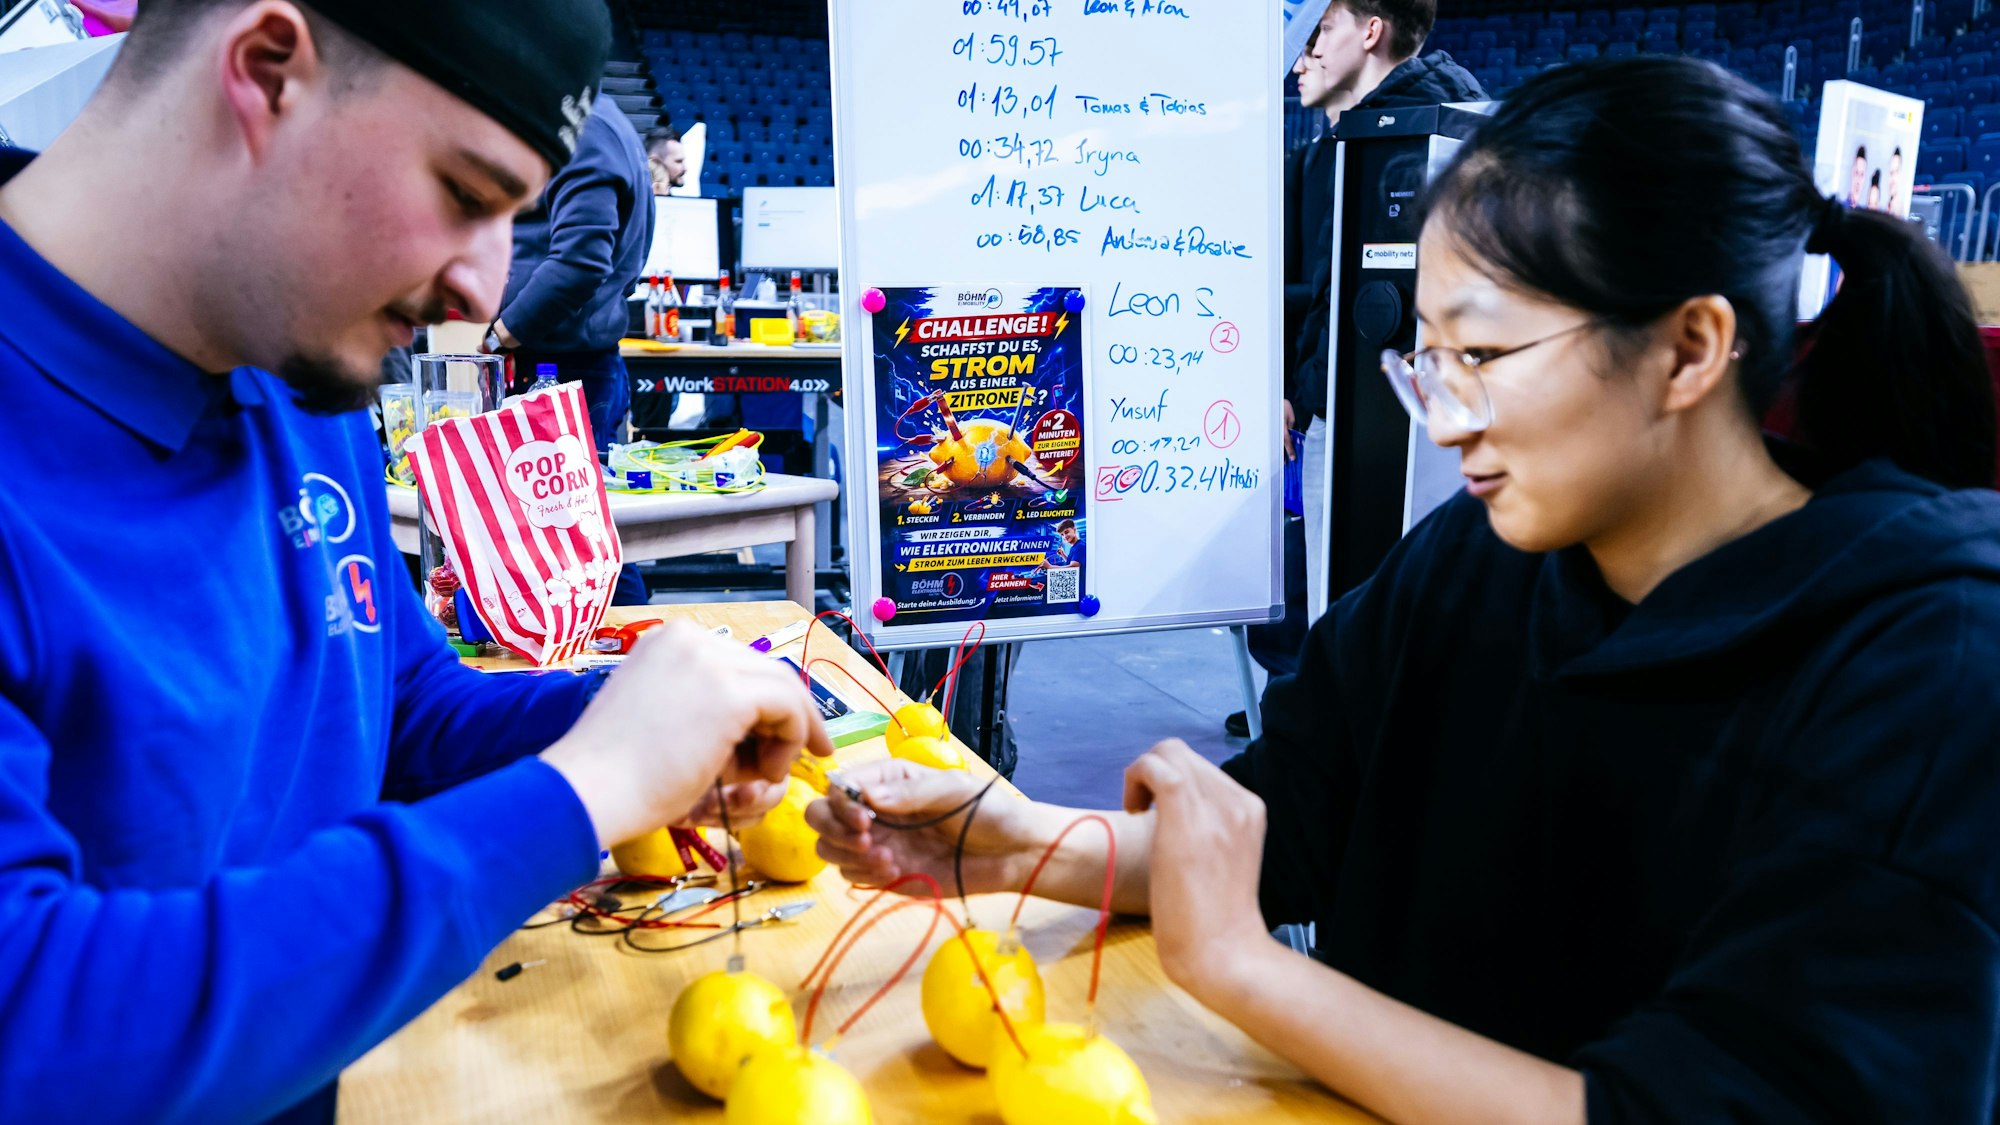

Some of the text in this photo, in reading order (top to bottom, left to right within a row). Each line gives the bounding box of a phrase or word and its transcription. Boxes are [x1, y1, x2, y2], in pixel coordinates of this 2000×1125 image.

[958, 82, 1207, 119] 01:13,01 Tomas & Tobias
[959, 133, 1059, 168] 00:34,72
[1080, 186, 1140, 213] Luca
[958, 291, 987, 301] BÖHM
[1108, 282, 1222, 319] Leon S.
[917, 316, 1048, 339] CHALLENGE!
[1219, 328, 1234, 346] 2
[921, 339, 1042, 358] SCHAFFST DU ES,
[929, 354, 1035, 380] STROM
[950, 377, 1017, 390] AUS EINER
[950, 389, 1048, 408] ZITRONE ?
[1110, 389, 1169, 422] Yusuf
[1042, 412, 1065, 431] IN 2
[1211, 411, 1228, 440] 1
[1038, 429, 1076, 440] MINUTEN
[1037, 440, 1077, 450] ZUR EIGENEN
[1040, 449, 1074, 460] BATTERIE!
[515, 452, 566, 482] POP
[532, 467, 589, 500] CORN
[537, 501, 564, 517] Fresh
[575, 494, 588, 508] Hot
[897, 515, 940, 525] 1. STECKEN
[951, 512, 1005, 523] 2. VERBINDEN
[1015, 509, 1026, 519] 3.
[1040, 509, 1075, 518] LEUCHTET!
[920, 529, 992, 540] WIR ZEIGEN DIR,
[900, 546, 921, 556] WIE
[914, 554, 1039, 569] STROM ZUM LEBEN ERWECKEN!
[911, 579, 944, 590] BÖHM
[990, 580, 1027, 588] SCANNEN!
[992, 573, 1009, 581] HIER
[897, 597, 976, 609] Starte deine Ausbildung!
